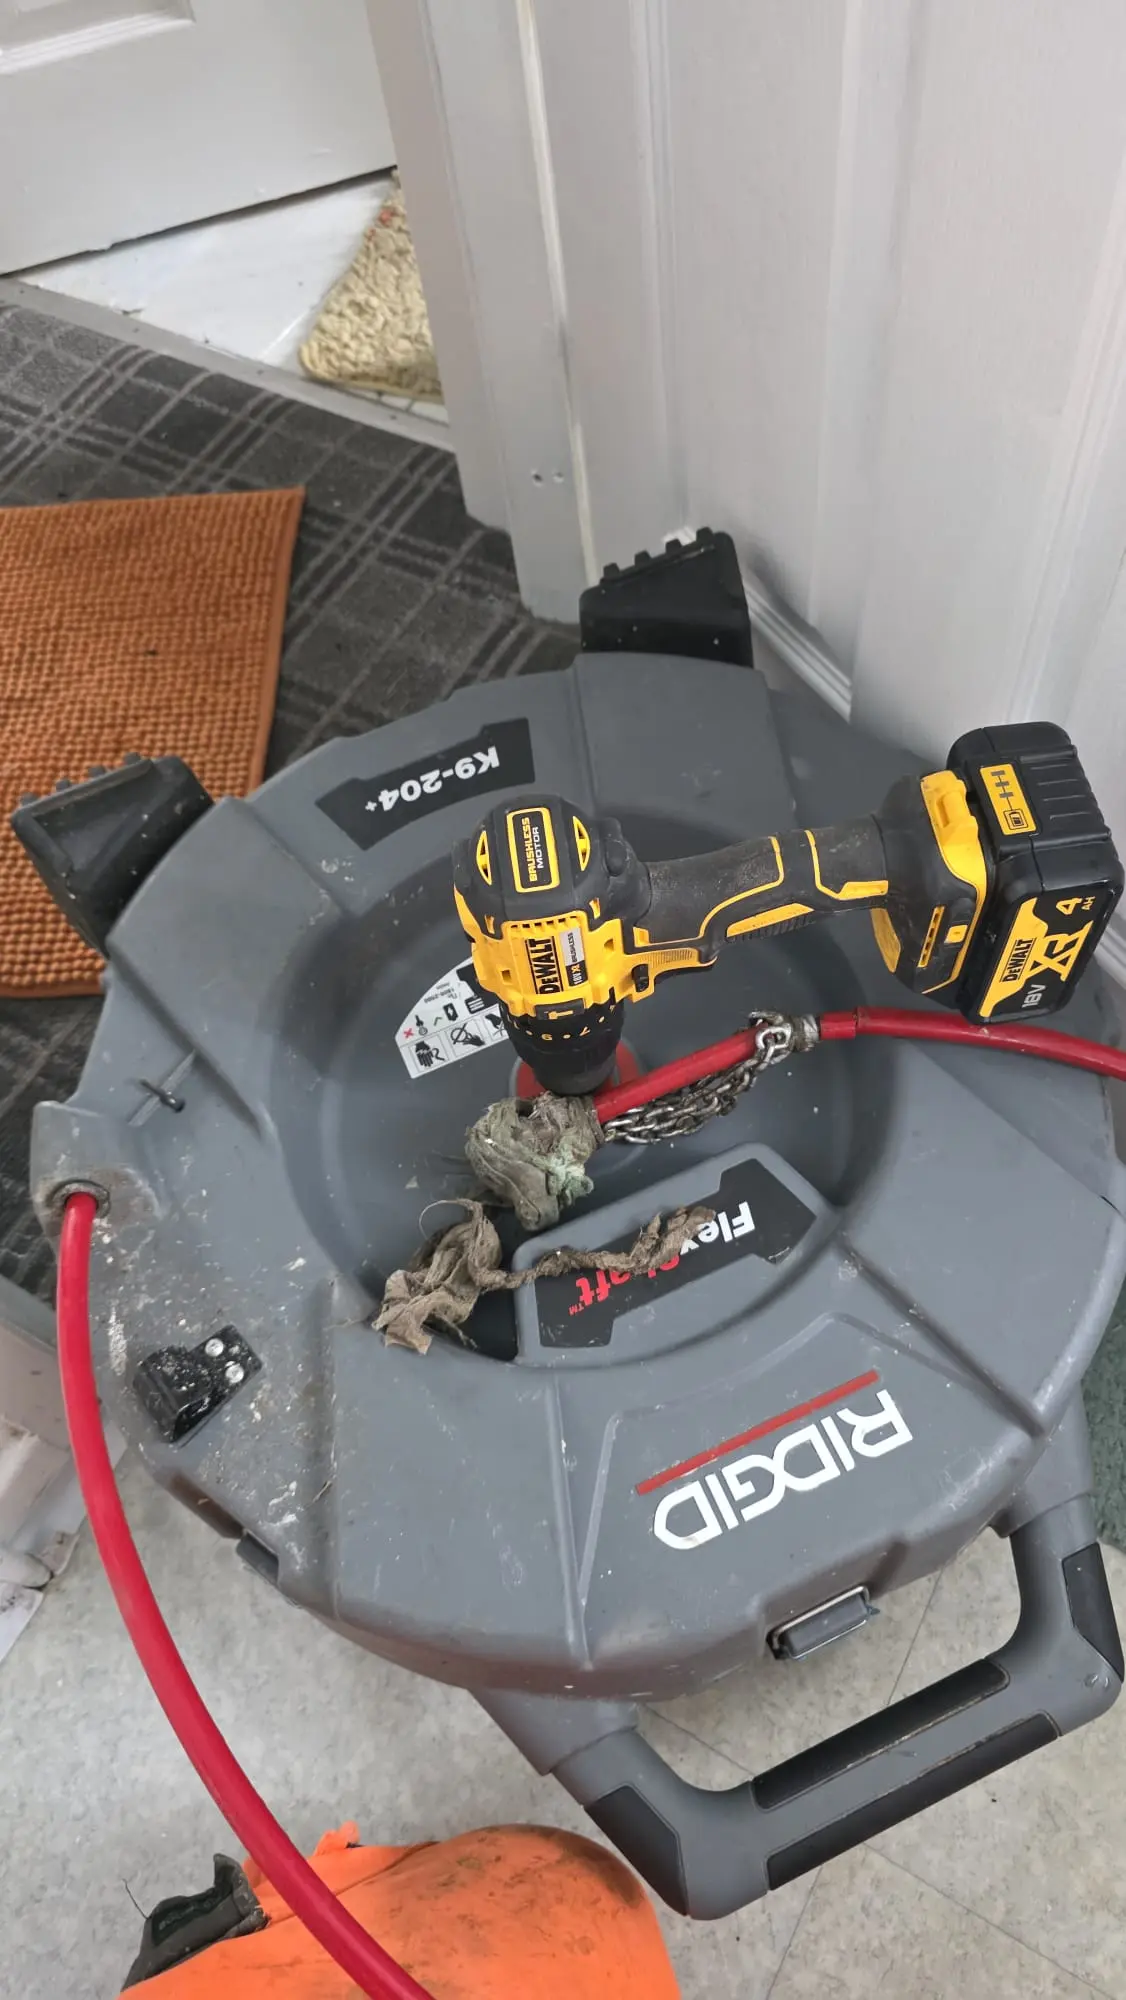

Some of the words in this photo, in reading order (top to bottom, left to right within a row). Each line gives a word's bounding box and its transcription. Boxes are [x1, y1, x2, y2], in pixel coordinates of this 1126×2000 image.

[365, 746, 500, 812] K9-204+
[521, 816, 538, 882] BRUSHLESS
[532, 826, 544, 869] MOTOR
[1055, 897, 1083, 915] 4
[1022, 984, 1046, 1008] 18V
[654, 1389, 913, 1549] RIDGID
